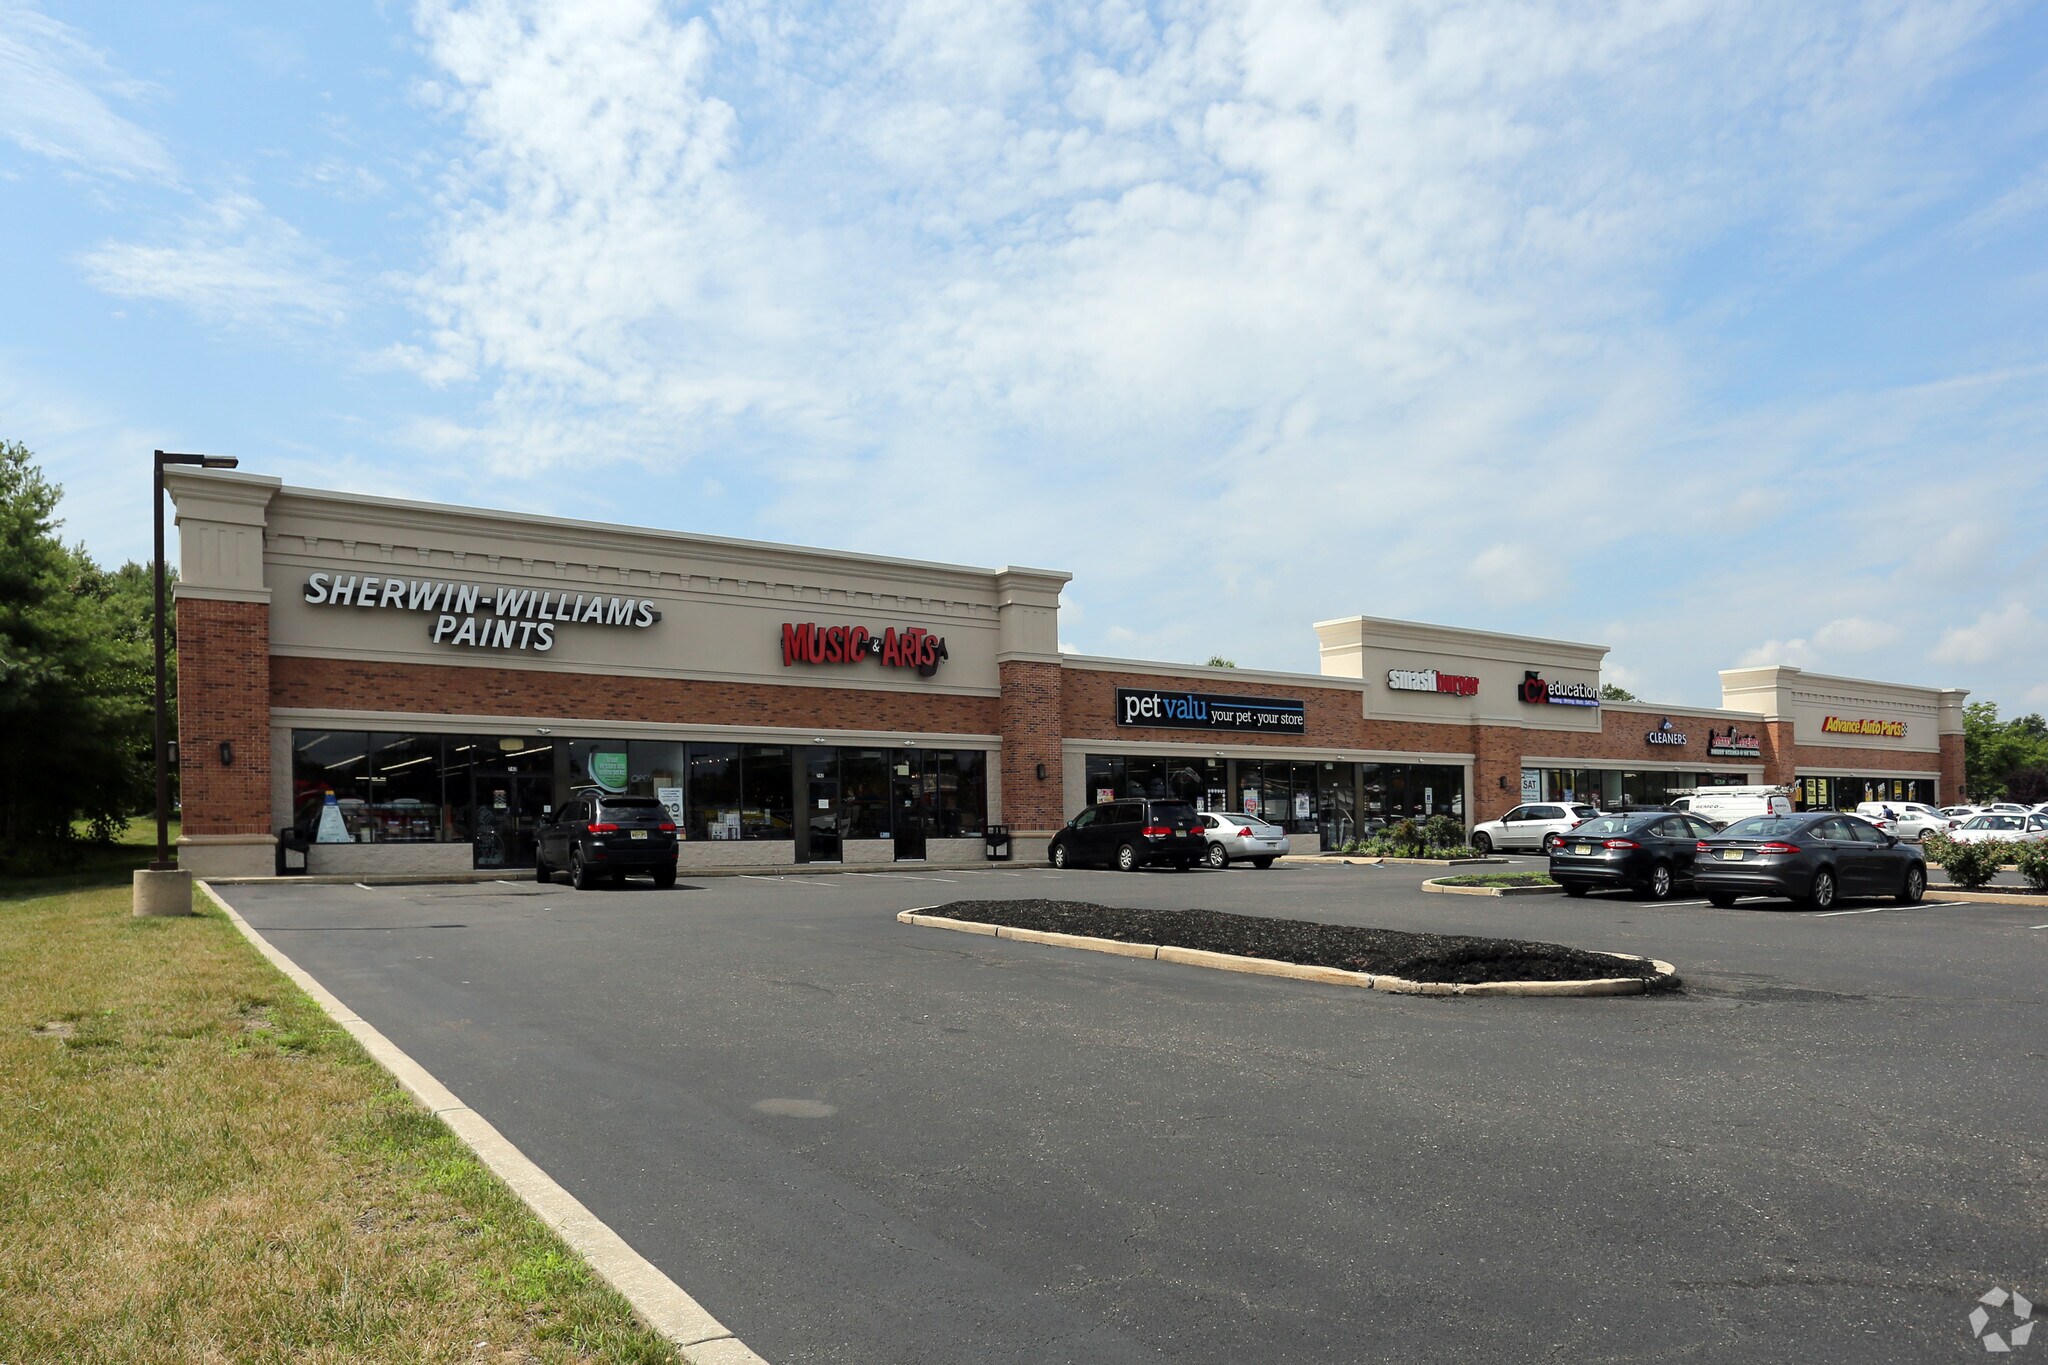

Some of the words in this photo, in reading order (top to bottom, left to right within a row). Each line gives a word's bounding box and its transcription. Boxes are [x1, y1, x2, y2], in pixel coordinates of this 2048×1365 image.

[304, 572, 655, 628] SHERWIN-WILLIAMS
[432, 614, 555, 651] PAINTS
[781, 622, 869, 667] MUSIC
[872, 638, 880, 653] &
[881, 626, 938, 668] ARTS
[1388, 669, 1480, 697] smashburger
[1524, 678, 1547, 704] C2
[1547, 680, 1599, 699] education
[1125, 693, 1162, 723] pet
[1162, 695, 1208, 720] valu
[1210, 710, 1235, 724] your
[1236, 711, 1252, 725] pet
[1257, 712, 1279, 726] your
[1280, 713, 1304, 725] store
[1649, 732, 1687, 745] CLEANERS
[1825, 716, 1860, 734] Advance
[1859, 719, 1881, 735] Auto
[1880, 720, 1902, 736] Parts
[1523, 780, 1536, 789] SAT
